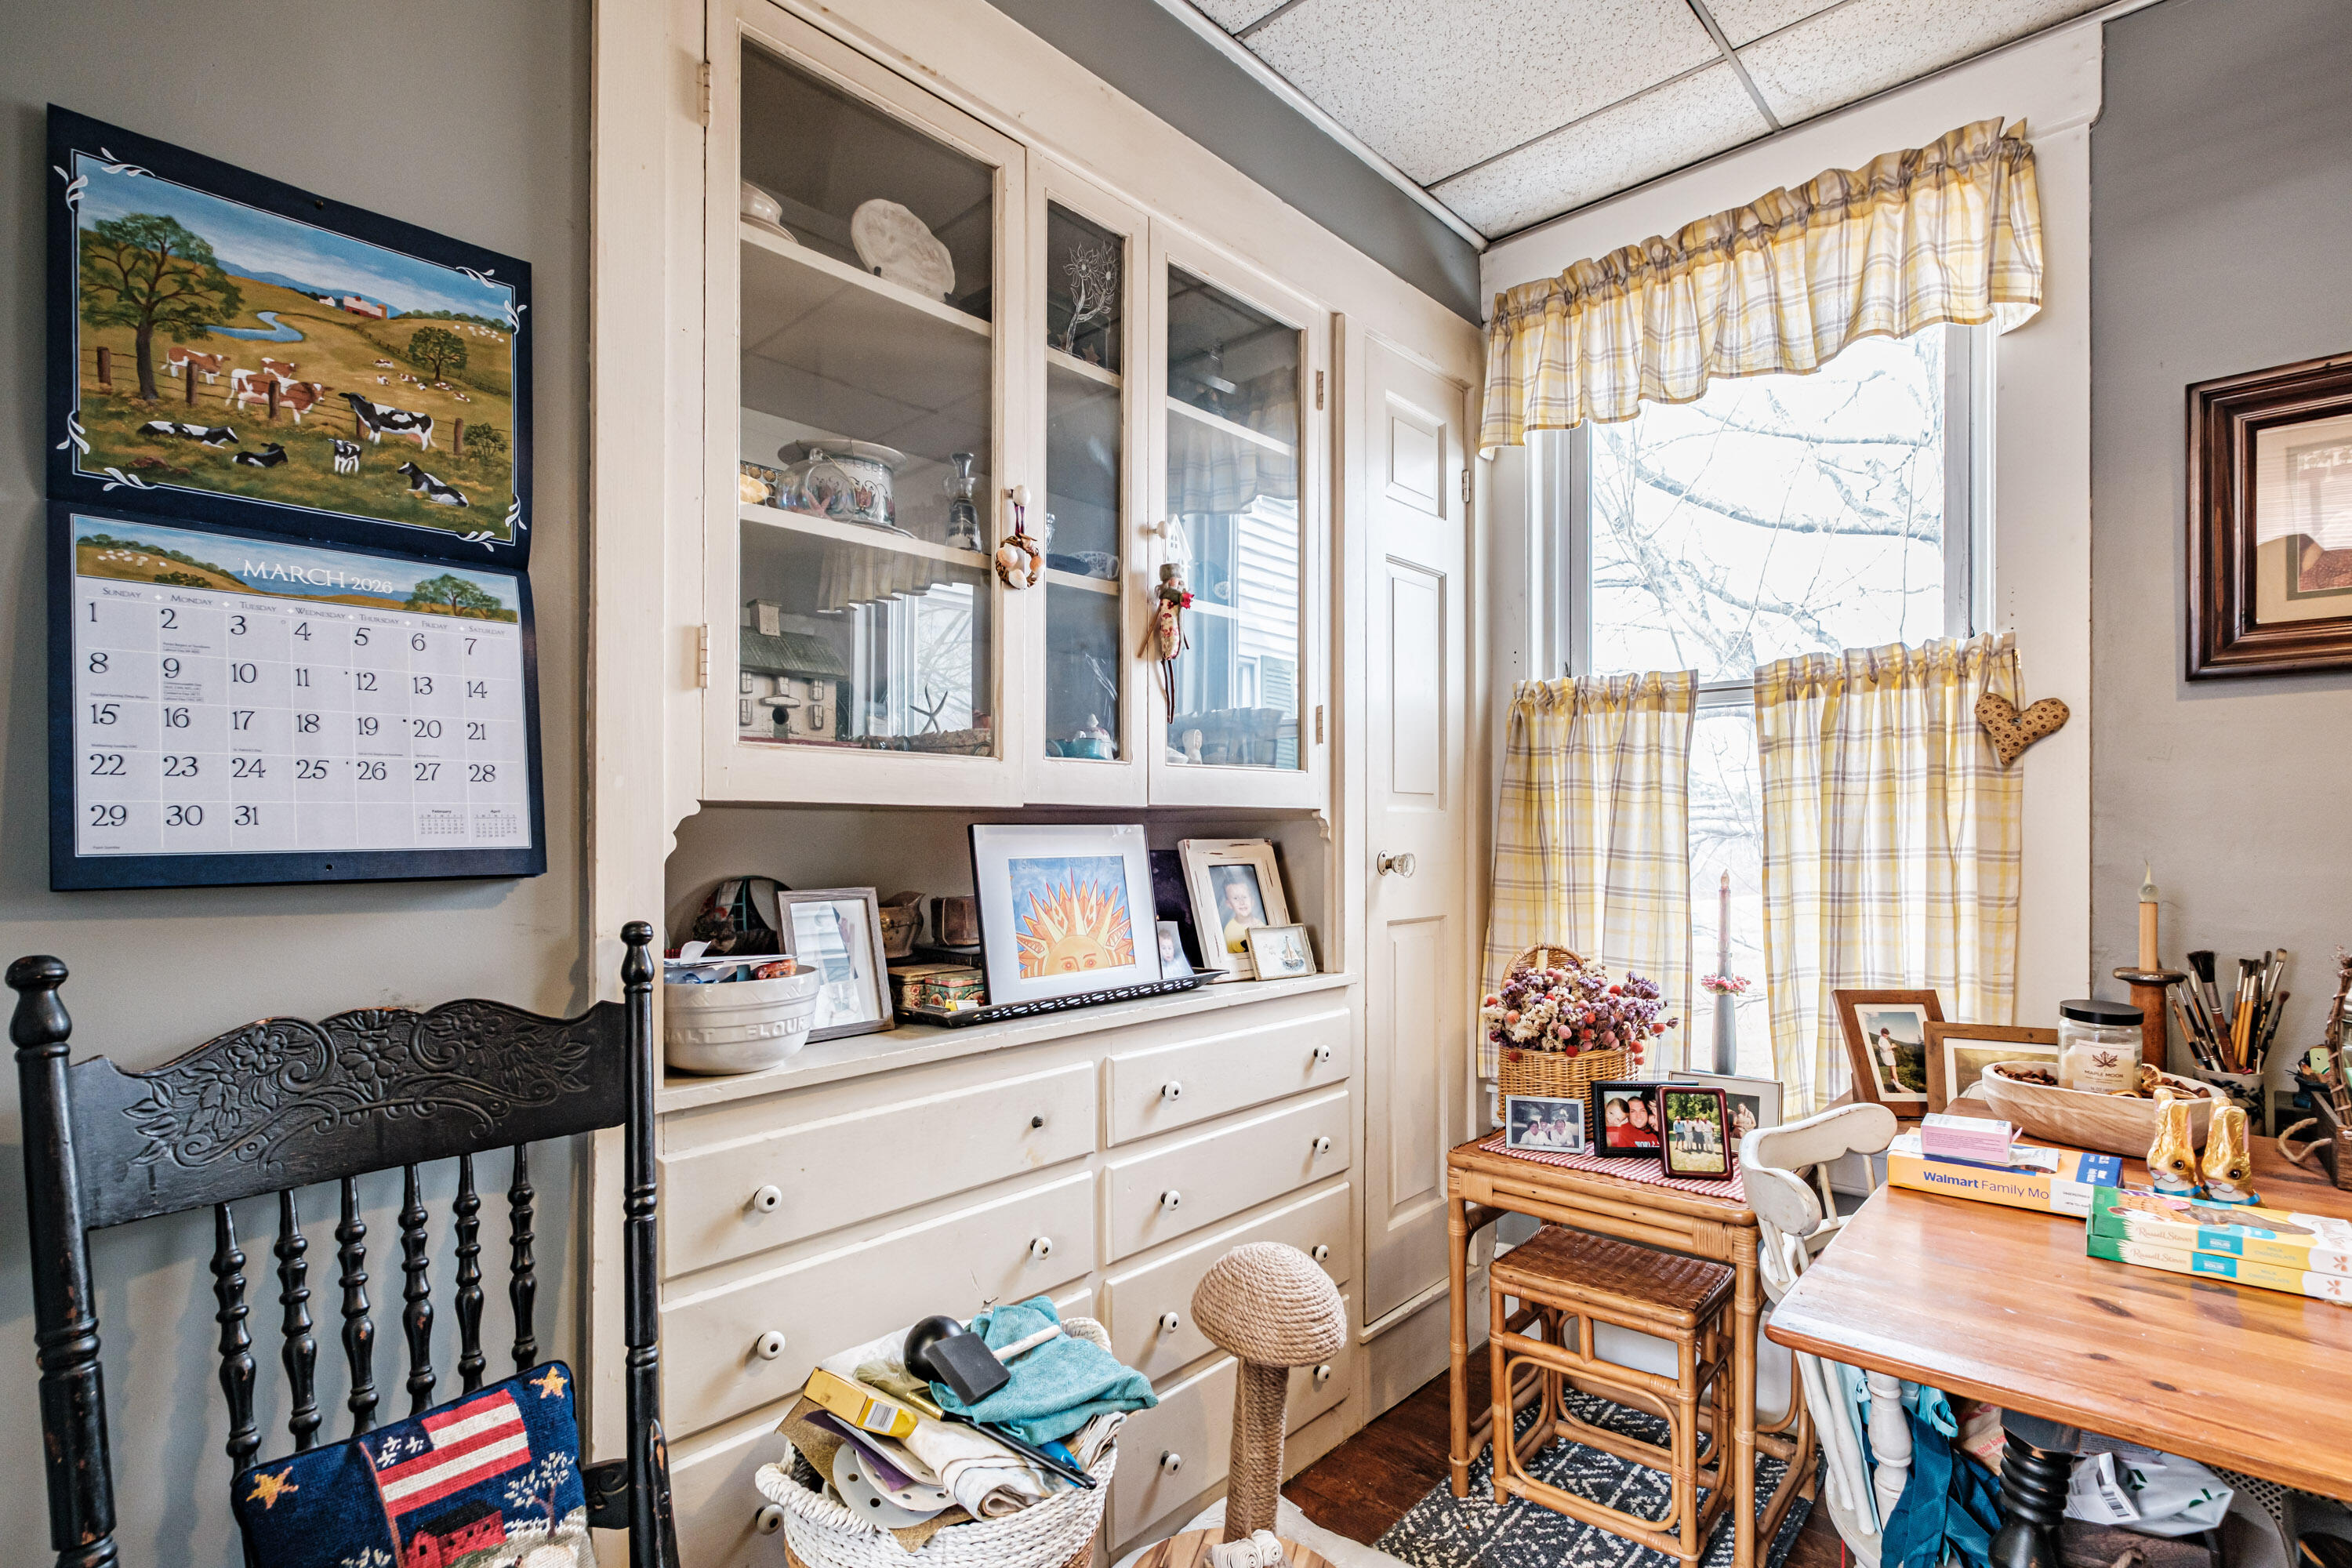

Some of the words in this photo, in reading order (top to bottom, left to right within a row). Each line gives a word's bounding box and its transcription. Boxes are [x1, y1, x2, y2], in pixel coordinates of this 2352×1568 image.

[243, 559, 346, 589] MARCH
[350, 575, 394, 594] 2026
[102, 586, 141, 600] SUNDAY
[171, 593, 213, 607] MONDAY
[239, 600, 278, 614] TUESDAY
[295, 607, 347, 621] WEDNESDAY
[358, 612, 401, 627] THURSDAY
[421, 620, 448, 631] FRIDAY
[468, 625, 506, 637] SATURDAY
[88, 602, 98, 623] 1
[161, 608, 179, 630] 2
[230, 615, 247, 635] 3
[294, 622, 313, 641] 4
[354, 627, 371, 646] 5
[411, 633, 427, 652] 6
[464, 637, 478, 656] 7
[89, 652, 109, 673] 8
[162, 658, 180, 680] 9
[231, 663, 257, 684] 10
[295, 668, 311, 688] 11
[356, 672, 379, 692] 12
[413, 677, 434, 695] 13
[466, 681, 488, 699] 14
[89, 703, 121, 726] 15
[163, 706, 193, 729] 16
[232, 710, 256, 731] 17
[296, 713, 321, 734] 18
[357, 717, 379, 736] 19
[413, 719, 442, 739] 20
[467, 722, 487, 741] 21
[89, 753, 127, 776] 22
[163, 756, 200, 778] 23
[231, 757, 267, 779] 24
[296, 759, 330, 780] 25
[358, 760, 387, 781] 26
[415, 762, 441, 782] 27
[468, 764, 496, 783] 28
[89, 804, 128, 827] 29
[165, 804, 204, 827] 30
[234, 805, 260, 826] 31
[1923, 1171, 1979, 1189] Walmart
[1981, 1180, 2025, 1198] Family
[2028, 1187, 2049, 1200] Mo
[2137, 1225, 2165, 1238] Russell
[2165, 1229, 2193, 1243] Stover
[2132, 1247, 2159, 1260] Russell
[2159, 1252, 2187, 1265] Stover
